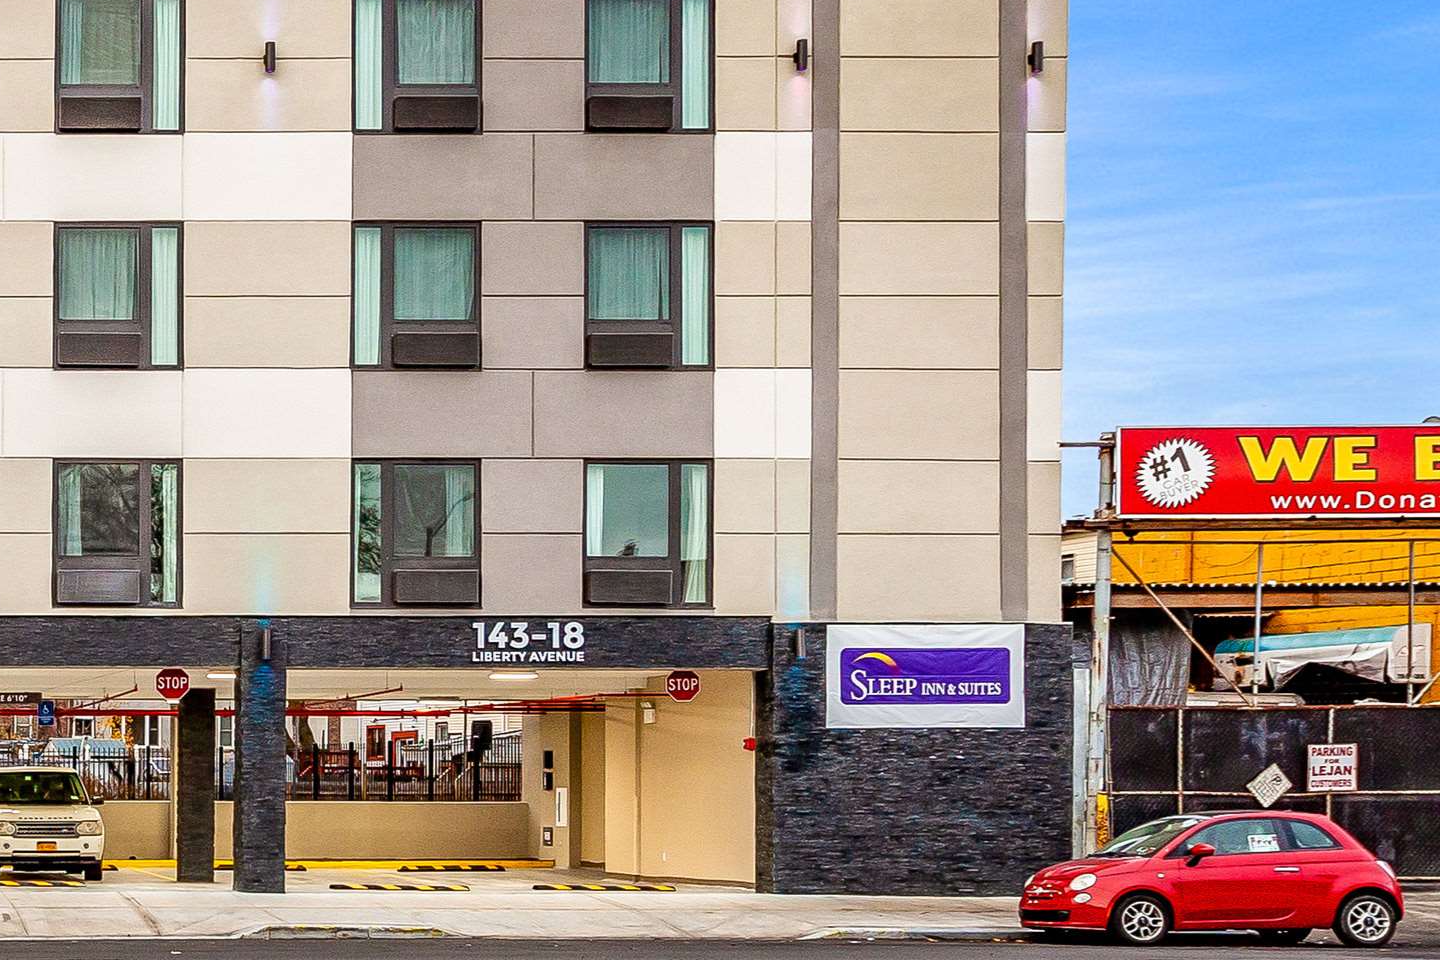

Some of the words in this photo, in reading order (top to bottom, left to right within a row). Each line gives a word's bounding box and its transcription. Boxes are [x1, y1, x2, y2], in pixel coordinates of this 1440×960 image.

[1149, 446, 1191, 482] #1
[1237, 436, 1377, 482] WE
[1160, 480, 1199, 500] BUYER
[1162, 473, 1190, 490] CAR
[1270, 490, 1440, 509] www.Dona
[472, 621, 585, 649] 143-18
[472, 651, 527, 662] LIBERTY
[528, 651, 585, 662] AVENUE
[157, 676, 188, 689] STOP
[668, 678, 698, 691] STOP
[850, 669, 918, 701] SLEEP
[921, 683, 946, 696] INN
[948, 684, 957, 696] &
[958, 682, 1002, 696] SUITES
[1311, 746, 1353, 756] PARKING
[1311, 765, 1353, 777] LEJAN
